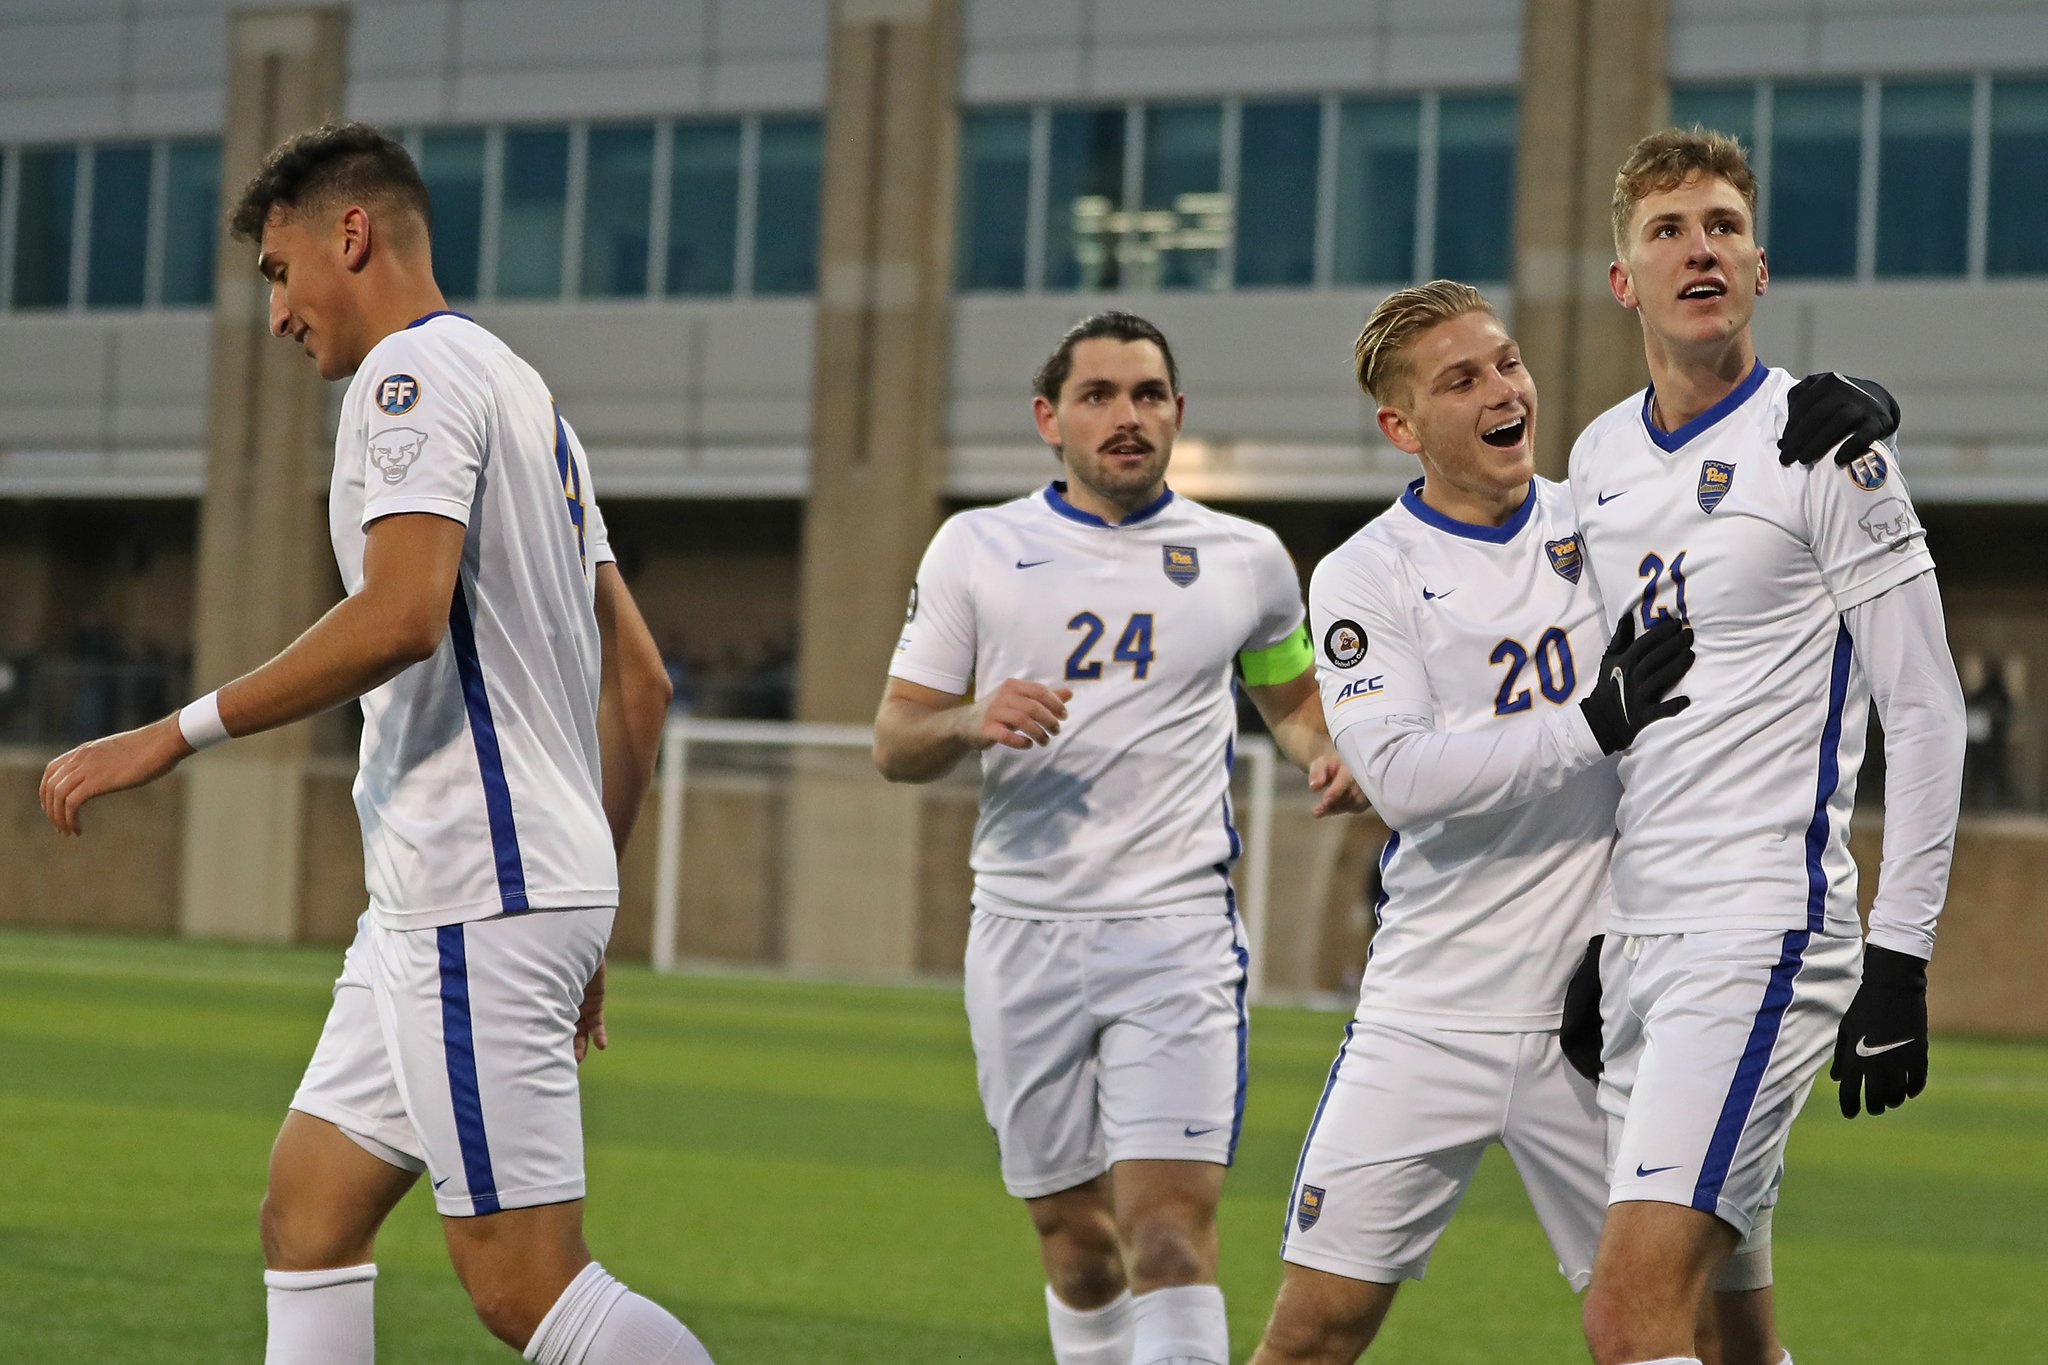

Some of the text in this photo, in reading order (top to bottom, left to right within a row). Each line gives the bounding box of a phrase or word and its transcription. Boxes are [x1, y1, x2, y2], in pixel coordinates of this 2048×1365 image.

[381, 381, 415, 406] FF
[1851, 450, 1881, 487] FF
[1638, 549, 1692, 632] 21
[1064, 610, 1156, 682] 24
[1488, 626, 1577, 718] 20
[1335, 675, 1384, 703] ACC
